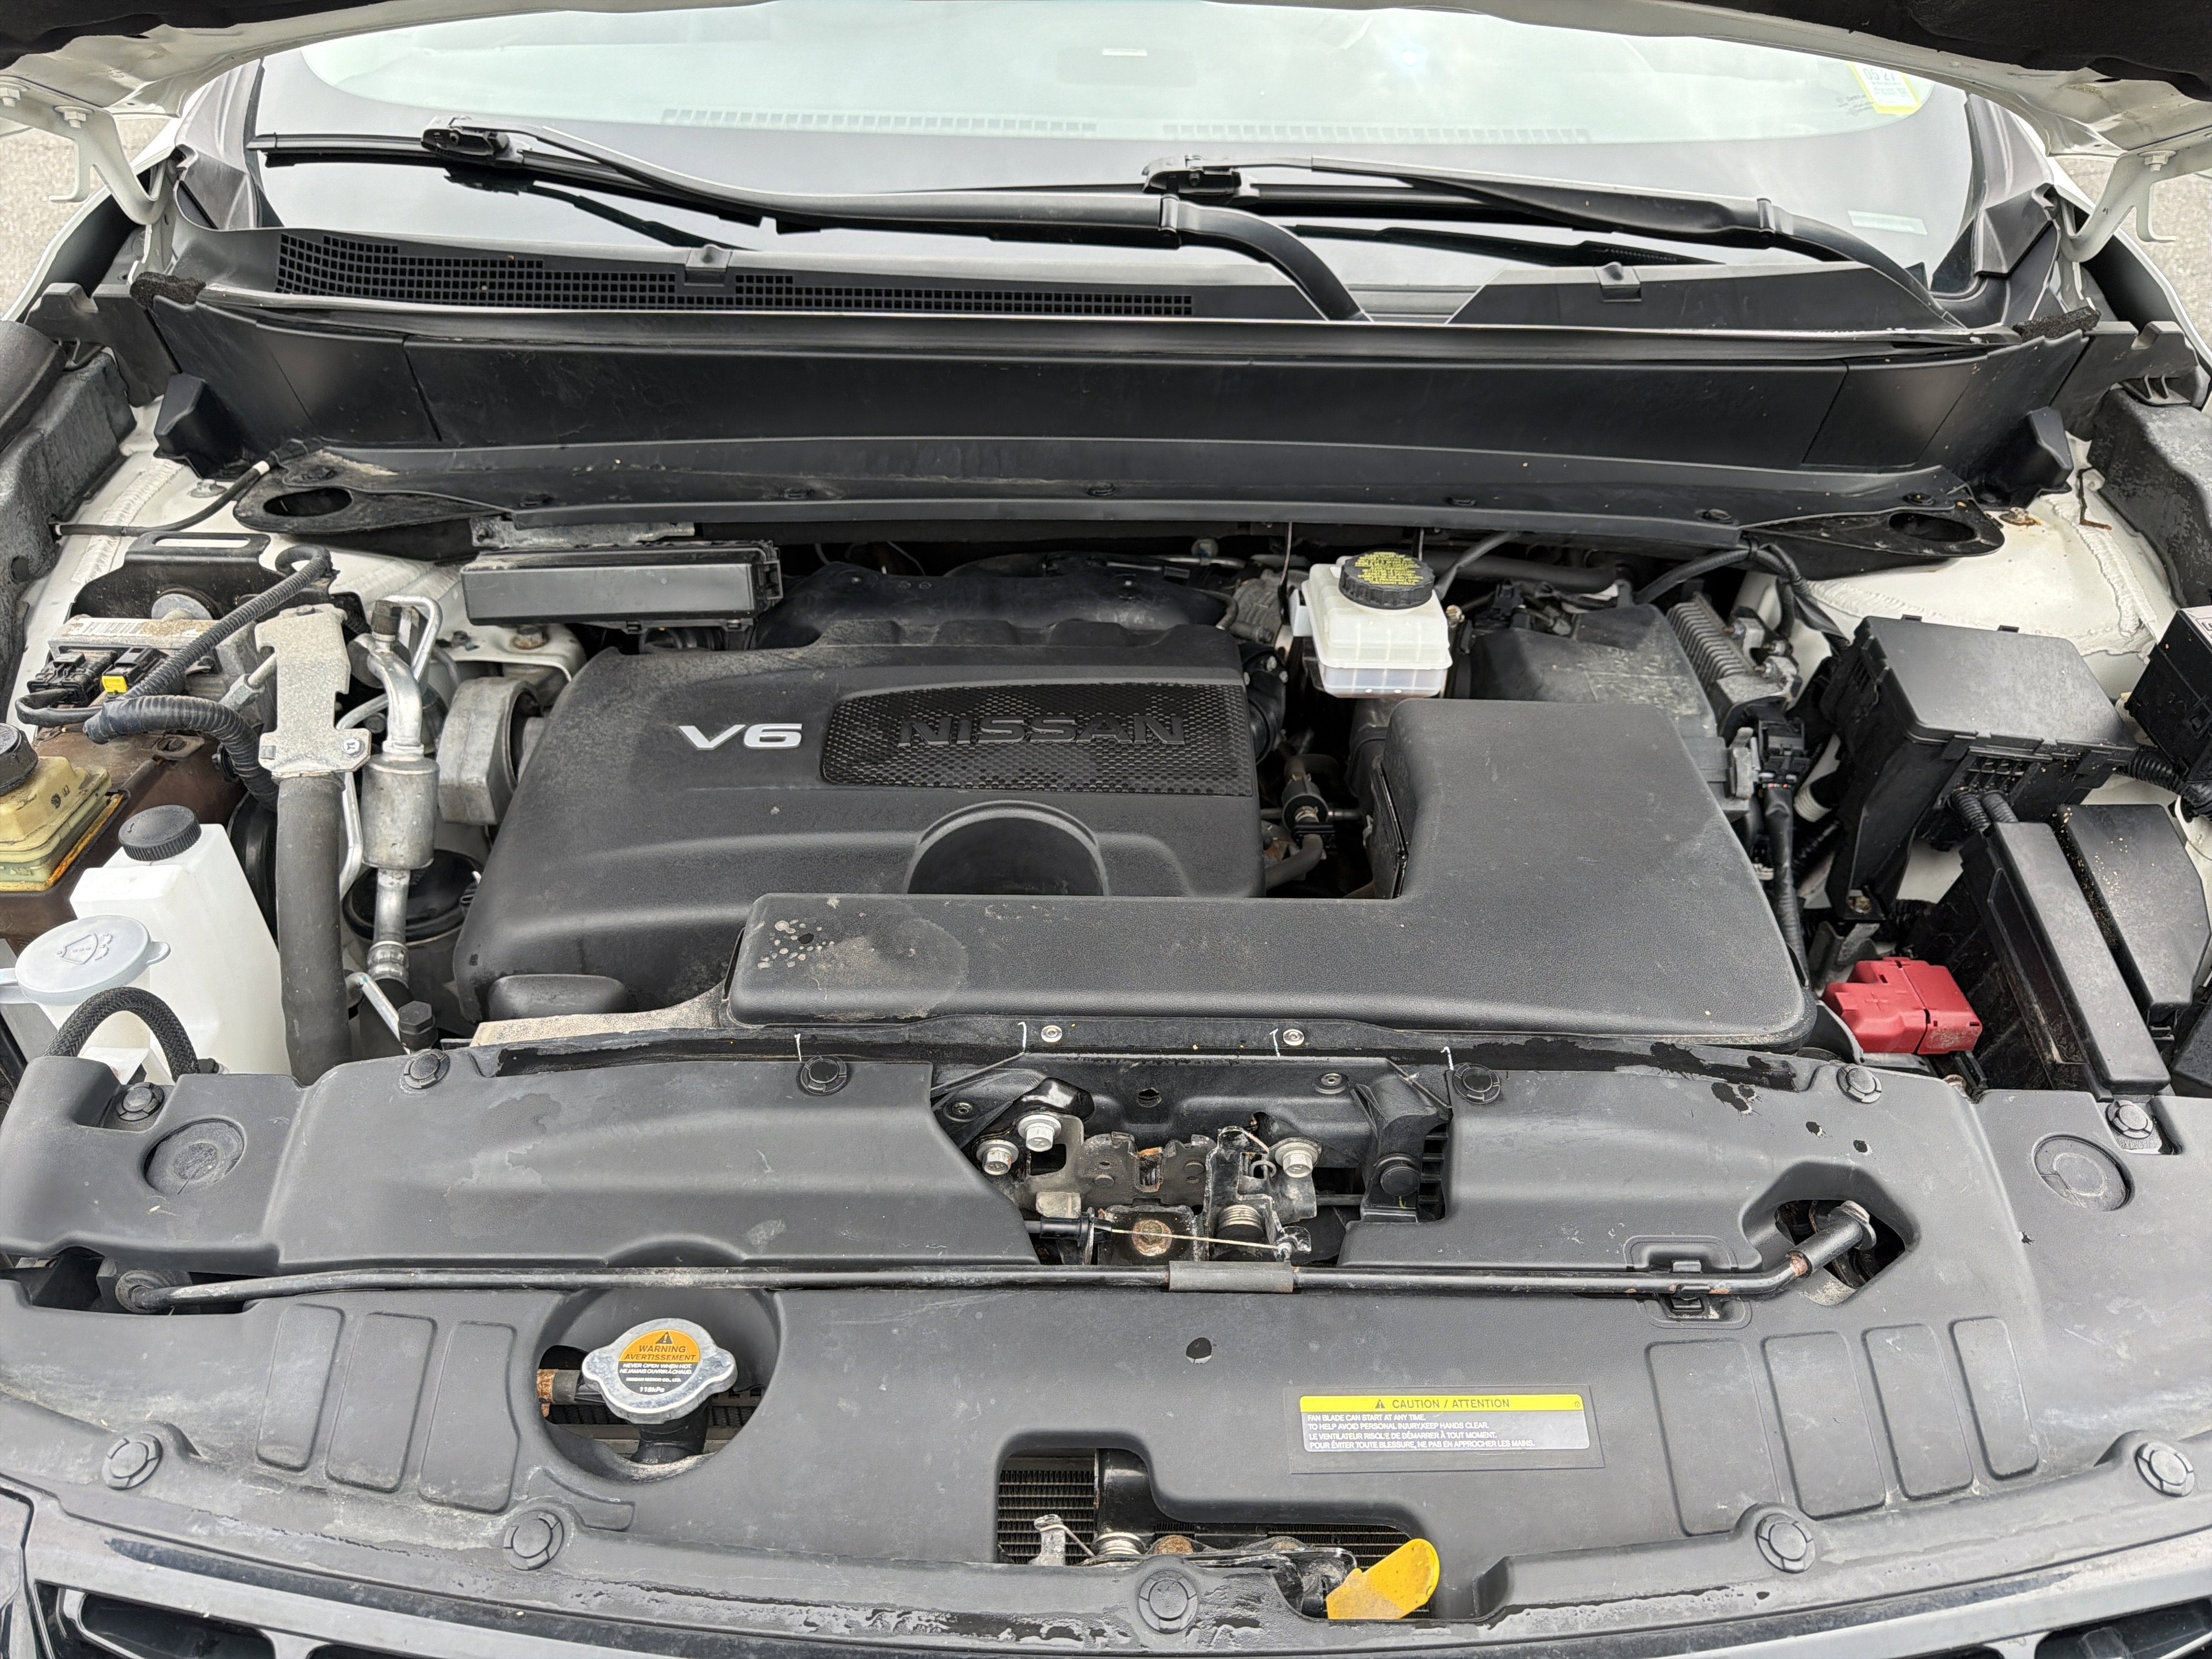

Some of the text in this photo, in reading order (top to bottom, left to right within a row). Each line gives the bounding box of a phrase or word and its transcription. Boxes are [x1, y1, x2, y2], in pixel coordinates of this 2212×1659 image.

[679, 714, 1185, 750] V6 NISSAN
[1392, 1400, 1440, 1408] CAUTION
[1452, 1399, 1510, 1408] ATTENTION
[1402, 1431, 1440, 1439] DÉMARRER
[1440, 1430, 1447, 1439] À
[1331, 1440, 1355, 1448] ÉVITER
[1379, 1441, 1417, 1449] BLESSURE,
